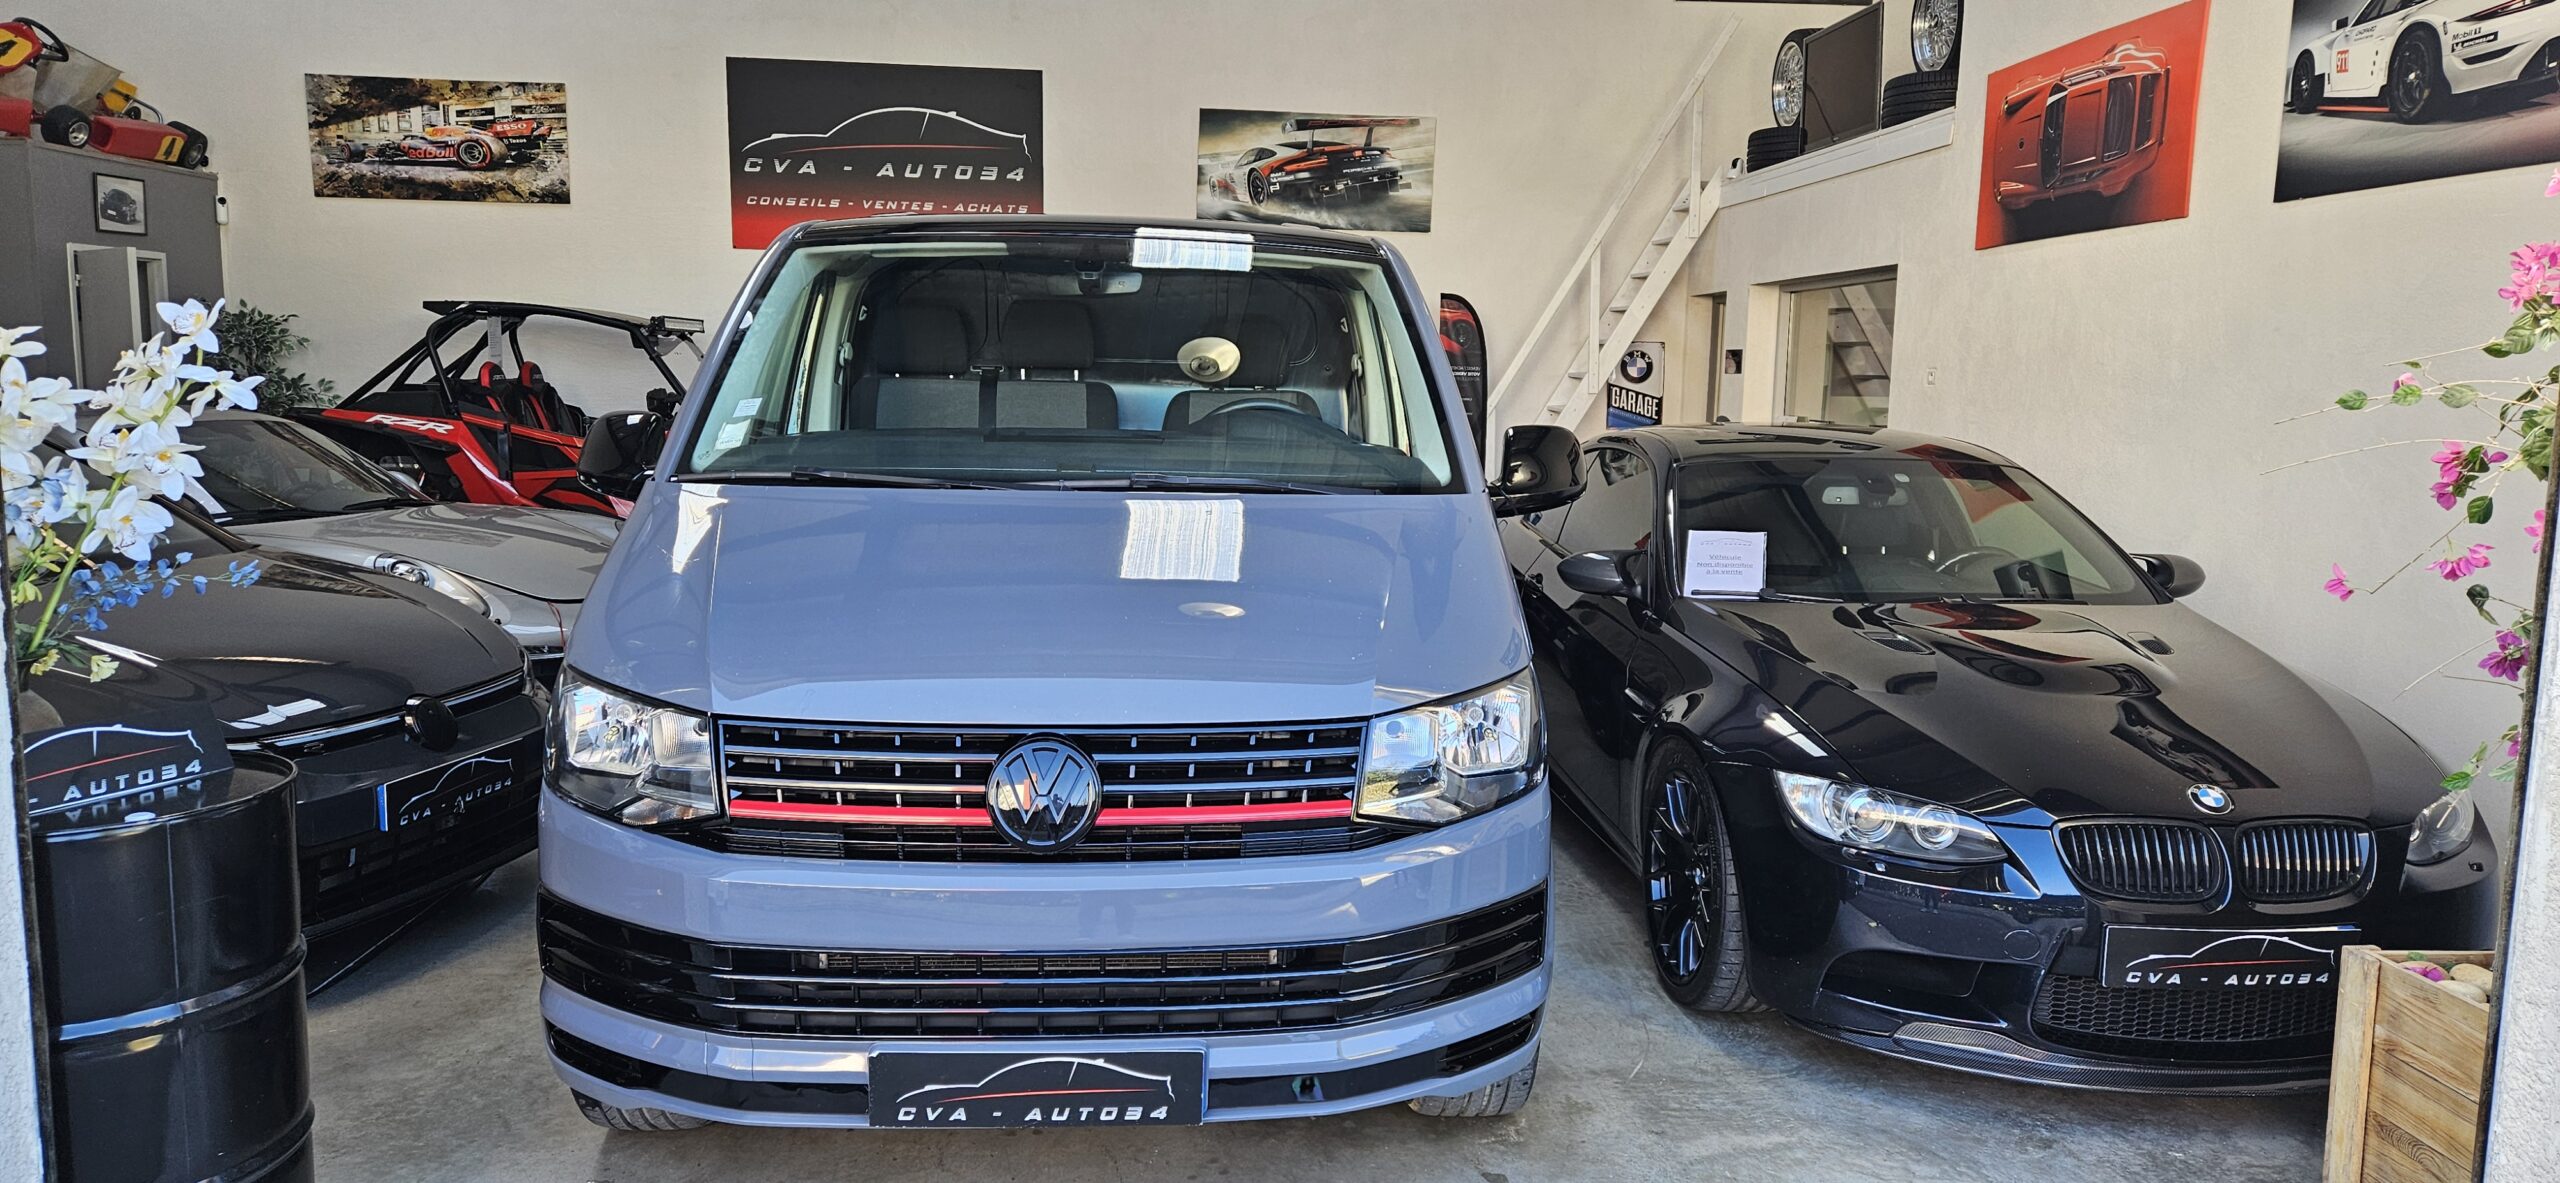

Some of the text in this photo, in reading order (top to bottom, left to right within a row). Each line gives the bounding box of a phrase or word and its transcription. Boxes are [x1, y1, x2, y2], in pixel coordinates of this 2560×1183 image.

[497, 122, 527, 131] ESSO
[162, 137, 178, 160] 4
[743, 157, 817, 175] CVA
[876, 162, 1025, 182] AUTO34
[746, 196, 841, 209] CONSEILS
[862, 199, 935, 211] VENTES
[954, 203, 1029, 214] ACHATS
[1623, 350, 1653, 364] BMW
[1611, 386, 1659, 420] GARAGE
[365, 414, 455, 434] RZR
[63, 759, 202, 801] AUTO34
[400, 807, 432, 826] CVA
[455, 777, 512, 806] AUTO34
[2126, 971, 2181, 985] CVA
[2224, 972, 2329, 986] AUTO34
[897, 1107, 967, 1122] CVA
[1024, 1106, 1169, 1122] AUTO34
